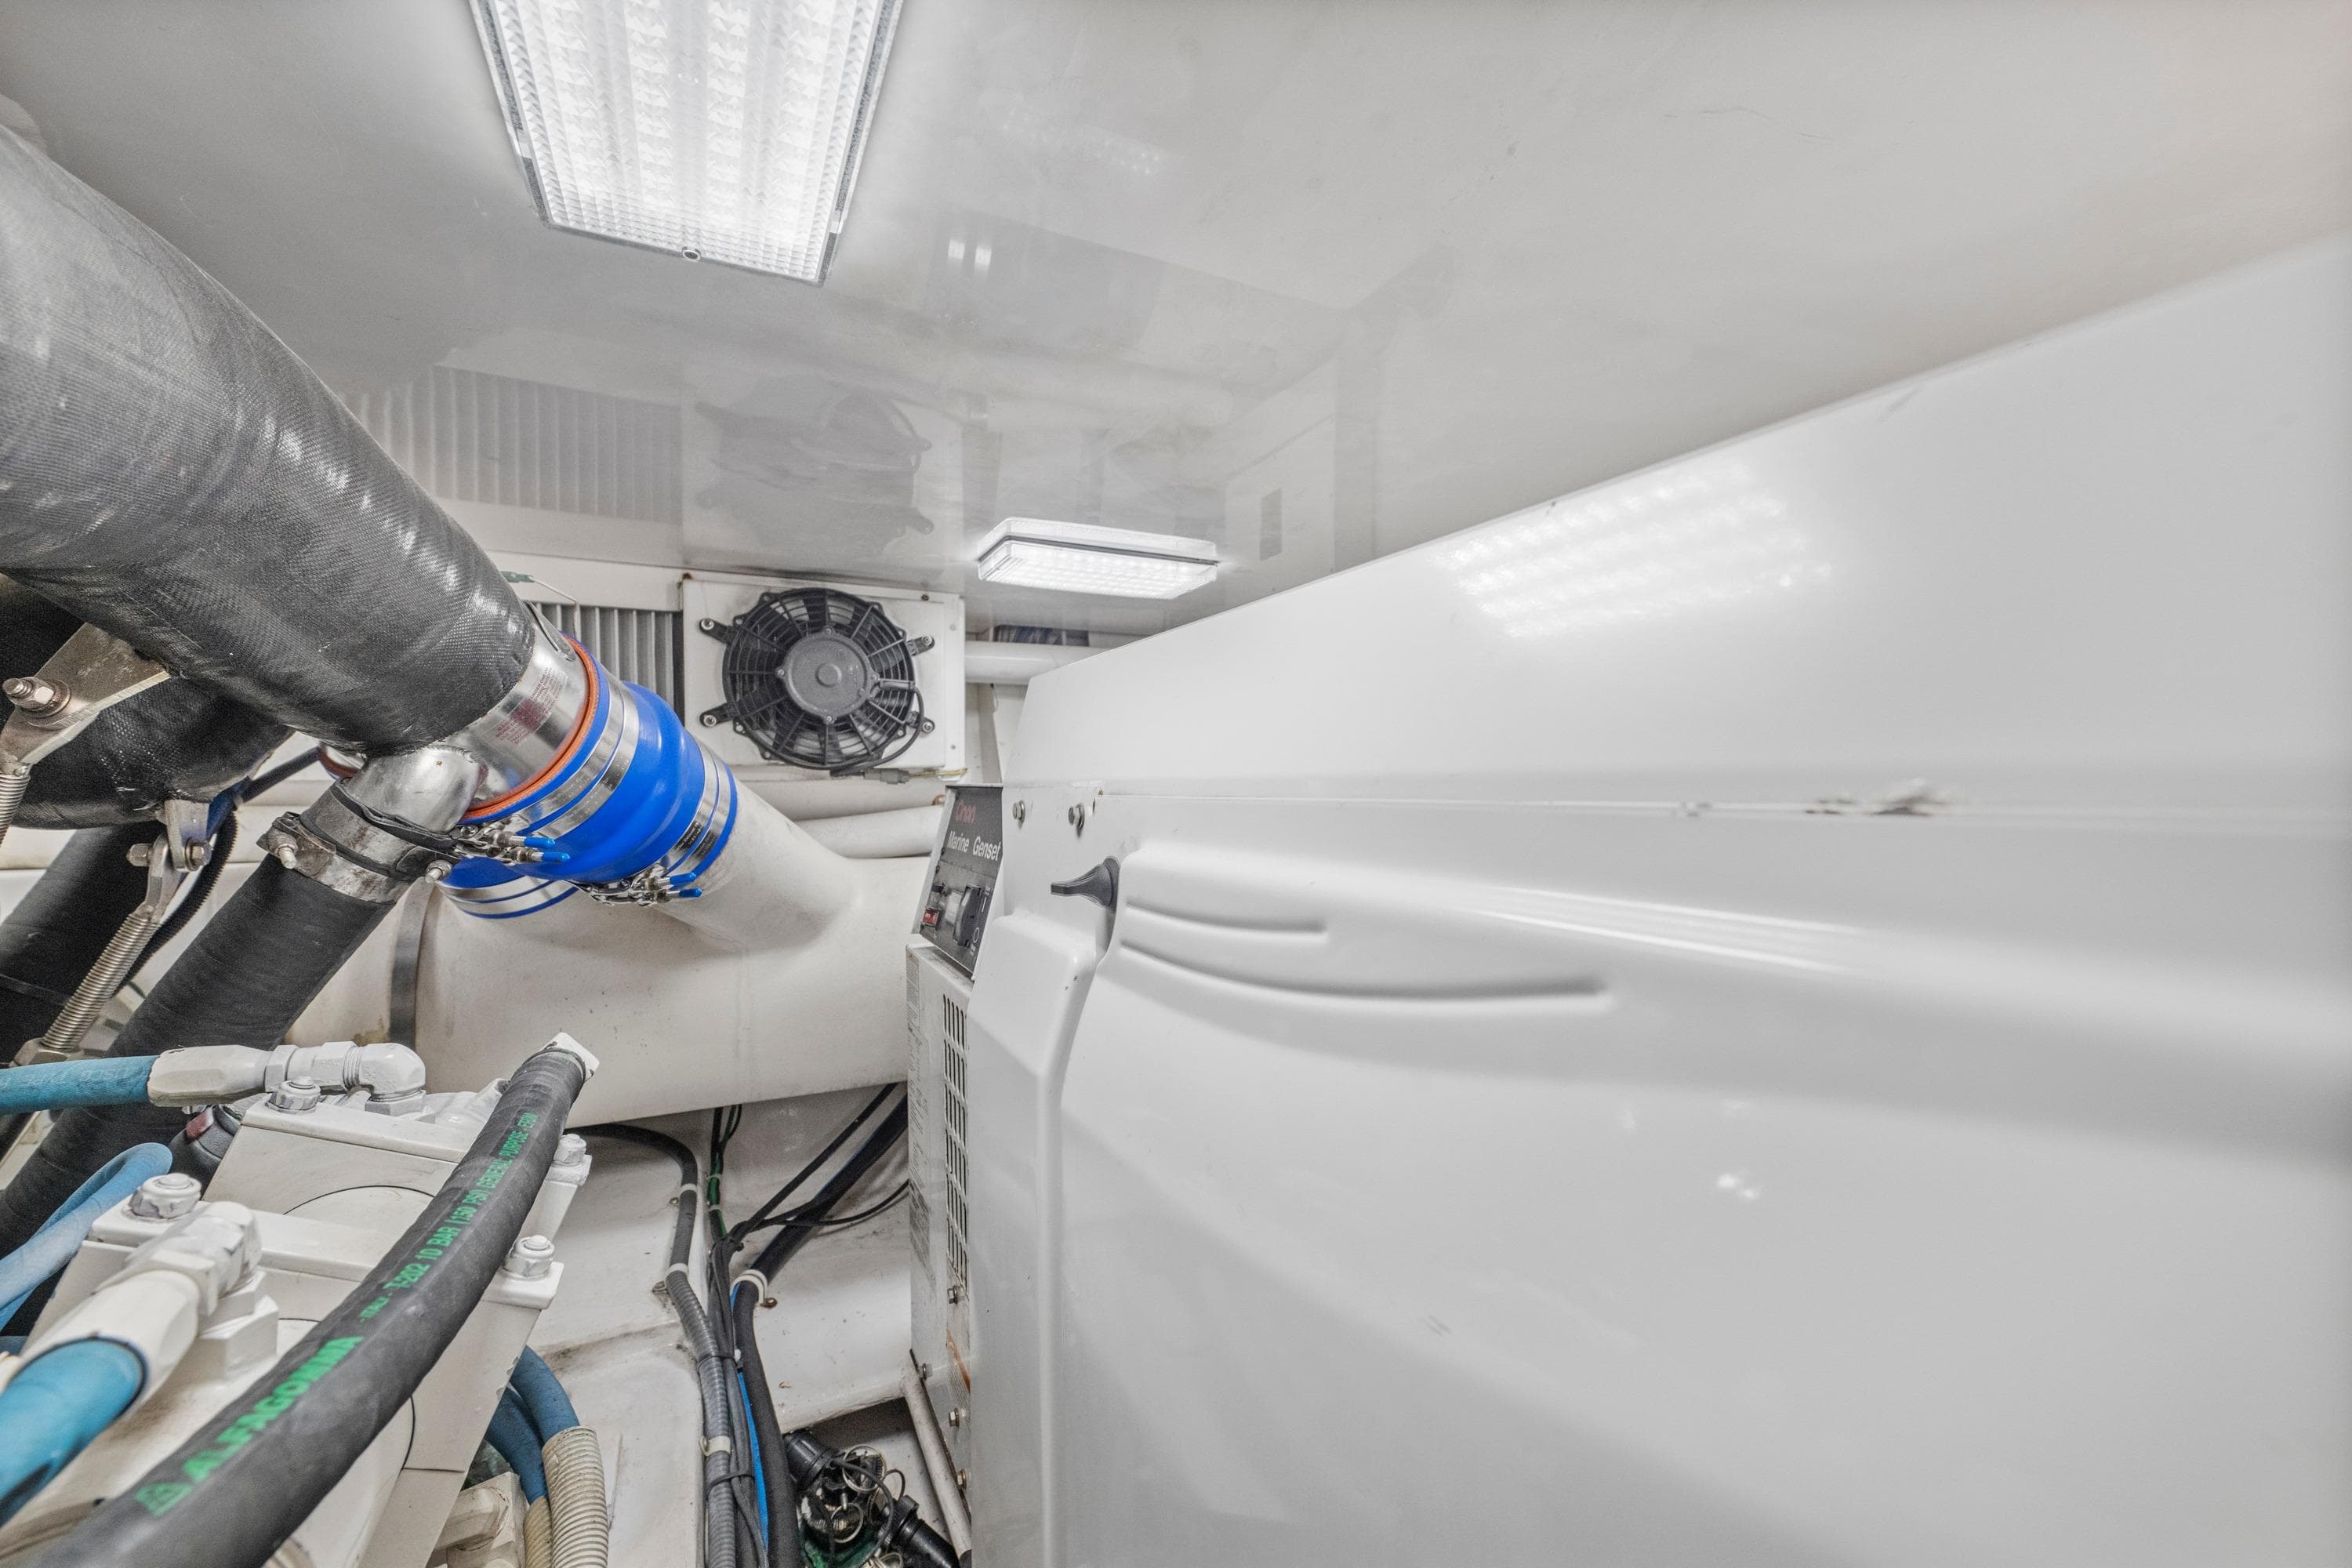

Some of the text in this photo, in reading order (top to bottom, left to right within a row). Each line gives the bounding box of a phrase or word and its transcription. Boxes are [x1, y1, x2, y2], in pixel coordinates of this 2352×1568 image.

[947, 830, 1002, 861] Marine Genset
[499, 1131, 529, 1158] PURPOSE
[476, 1156, 514, 1190] GENERAL
[444, 1206, 477, 1225] (150
[426, 1225, 461, 1247] BAR
[415, 1247, 443, 1261] 10
